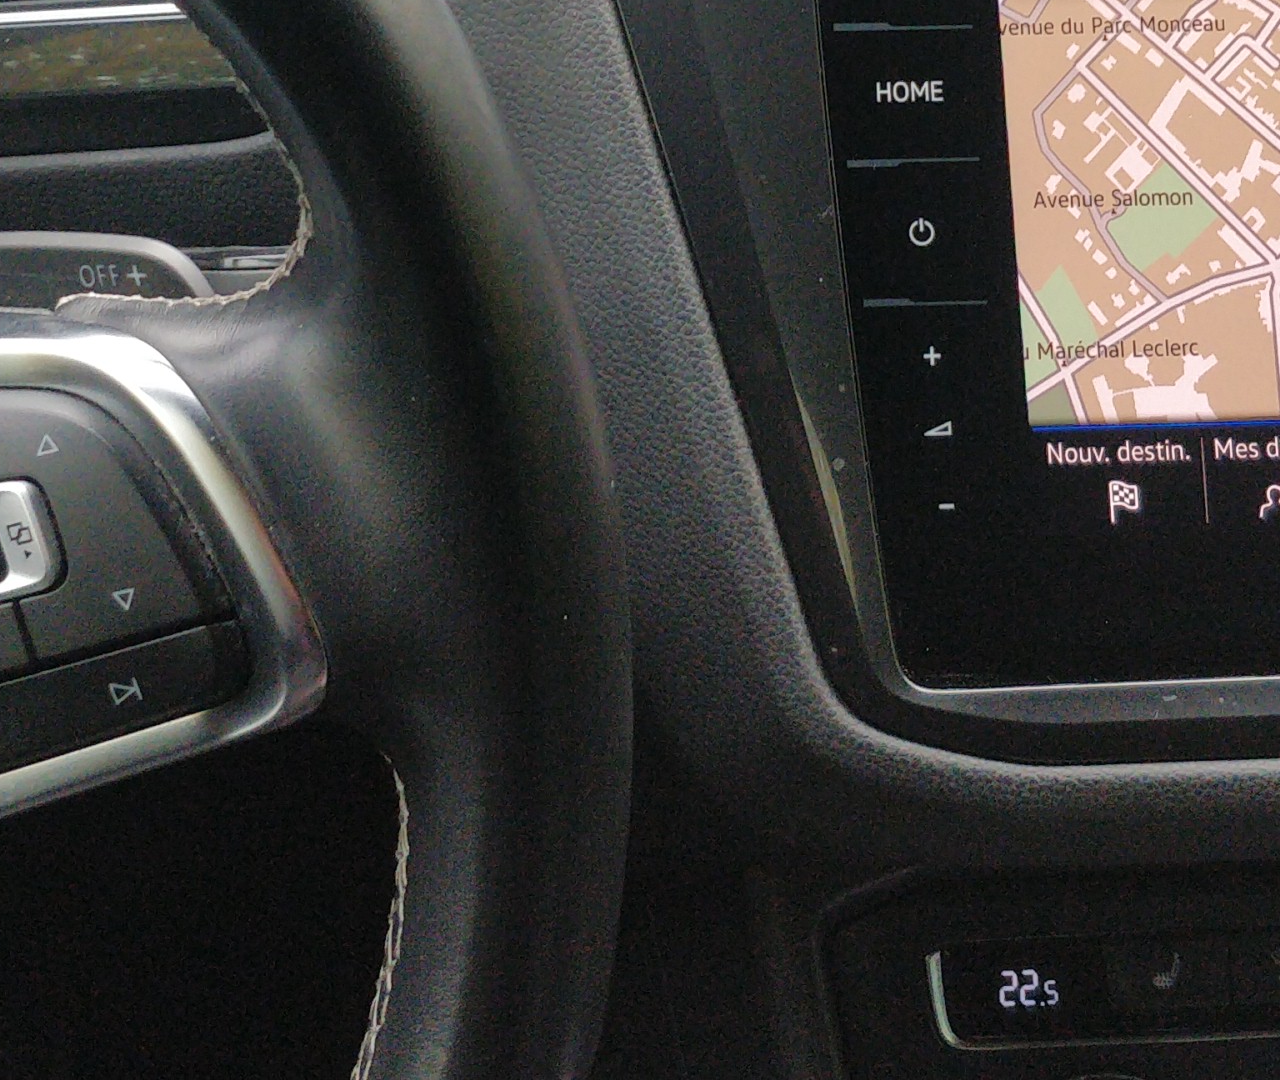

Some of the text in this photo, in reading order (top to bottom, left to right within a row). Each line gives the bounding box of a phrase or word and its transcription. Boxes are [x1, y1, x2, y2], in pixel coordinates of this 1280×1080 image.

[1061, 18, 1084, 35] du
[1091, 16, 1134, 34] Parc
[875, 80, 944, 103] HOME
[1033, 189, 1194, 209] Avenue Salomon
[79, 264, 120, 289] OFF
[1037, 340, 1125, 360] Maréchal
[1132, 340, 1199, 358] Leclerc
[1046, 440, 1191, 465] Nouv. destin.
[1214, 438, 1260, 460] Mes
[999, 969, 1059, 1008] 22.5
